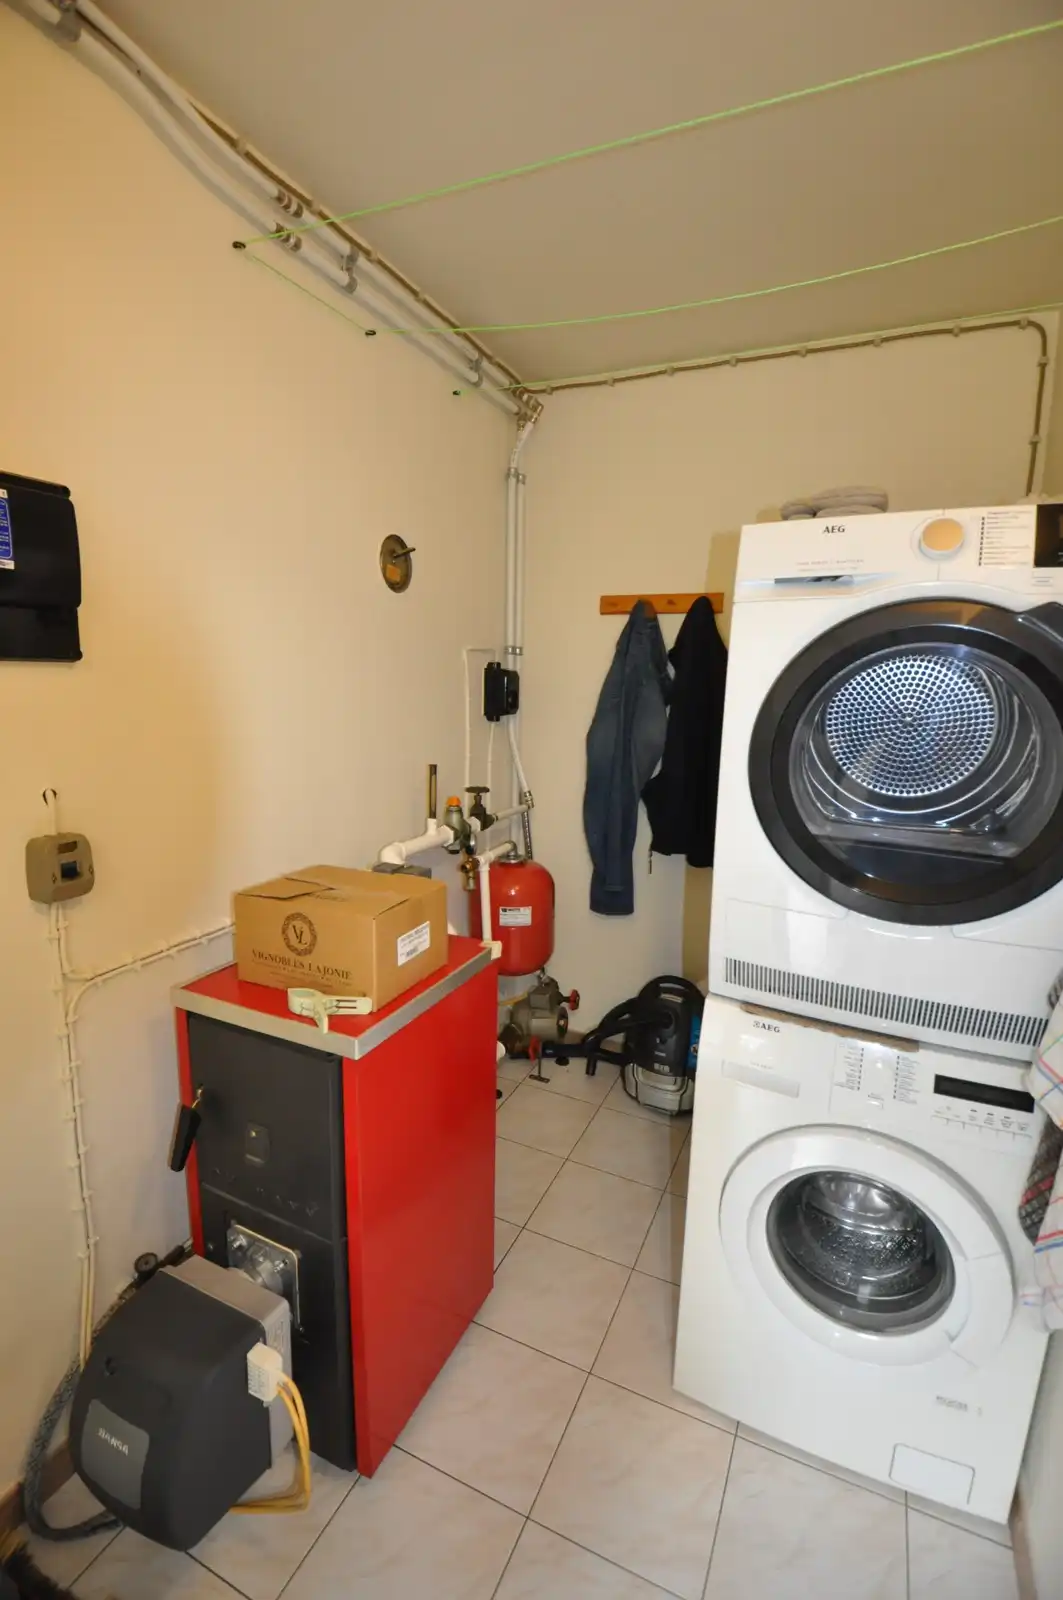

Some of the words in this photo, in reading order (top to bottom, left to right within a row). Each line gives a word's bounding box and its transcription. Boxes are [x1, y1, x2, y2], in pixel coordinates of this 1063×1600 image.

[823, 525, 846, 534] AEG
[251, 948, 305, 969] VIGNOBLES
[308, 961, 353, 980] LAJONIE
[760, 1022, 781, 1033] AEG
